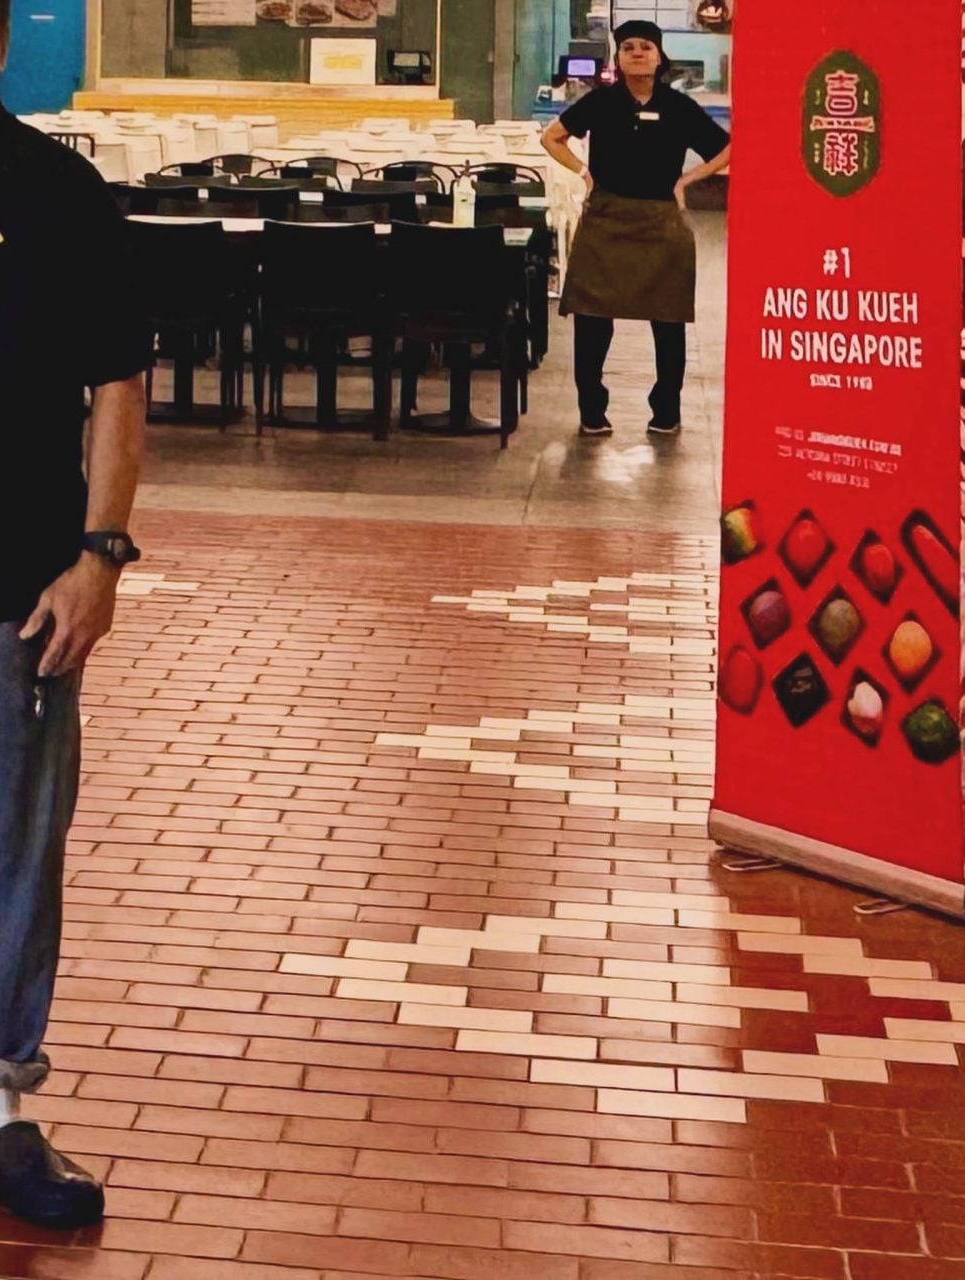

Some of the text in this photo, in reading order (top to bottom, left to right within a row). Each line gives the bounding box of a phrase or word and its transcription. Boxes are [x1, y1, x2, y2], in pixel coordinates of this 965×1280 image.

[822, 246, 851, 279] #1
[762, 286, 919, 325] ANG KU KUEH
[761, 327, 923, 369] IN SINGAPORE
